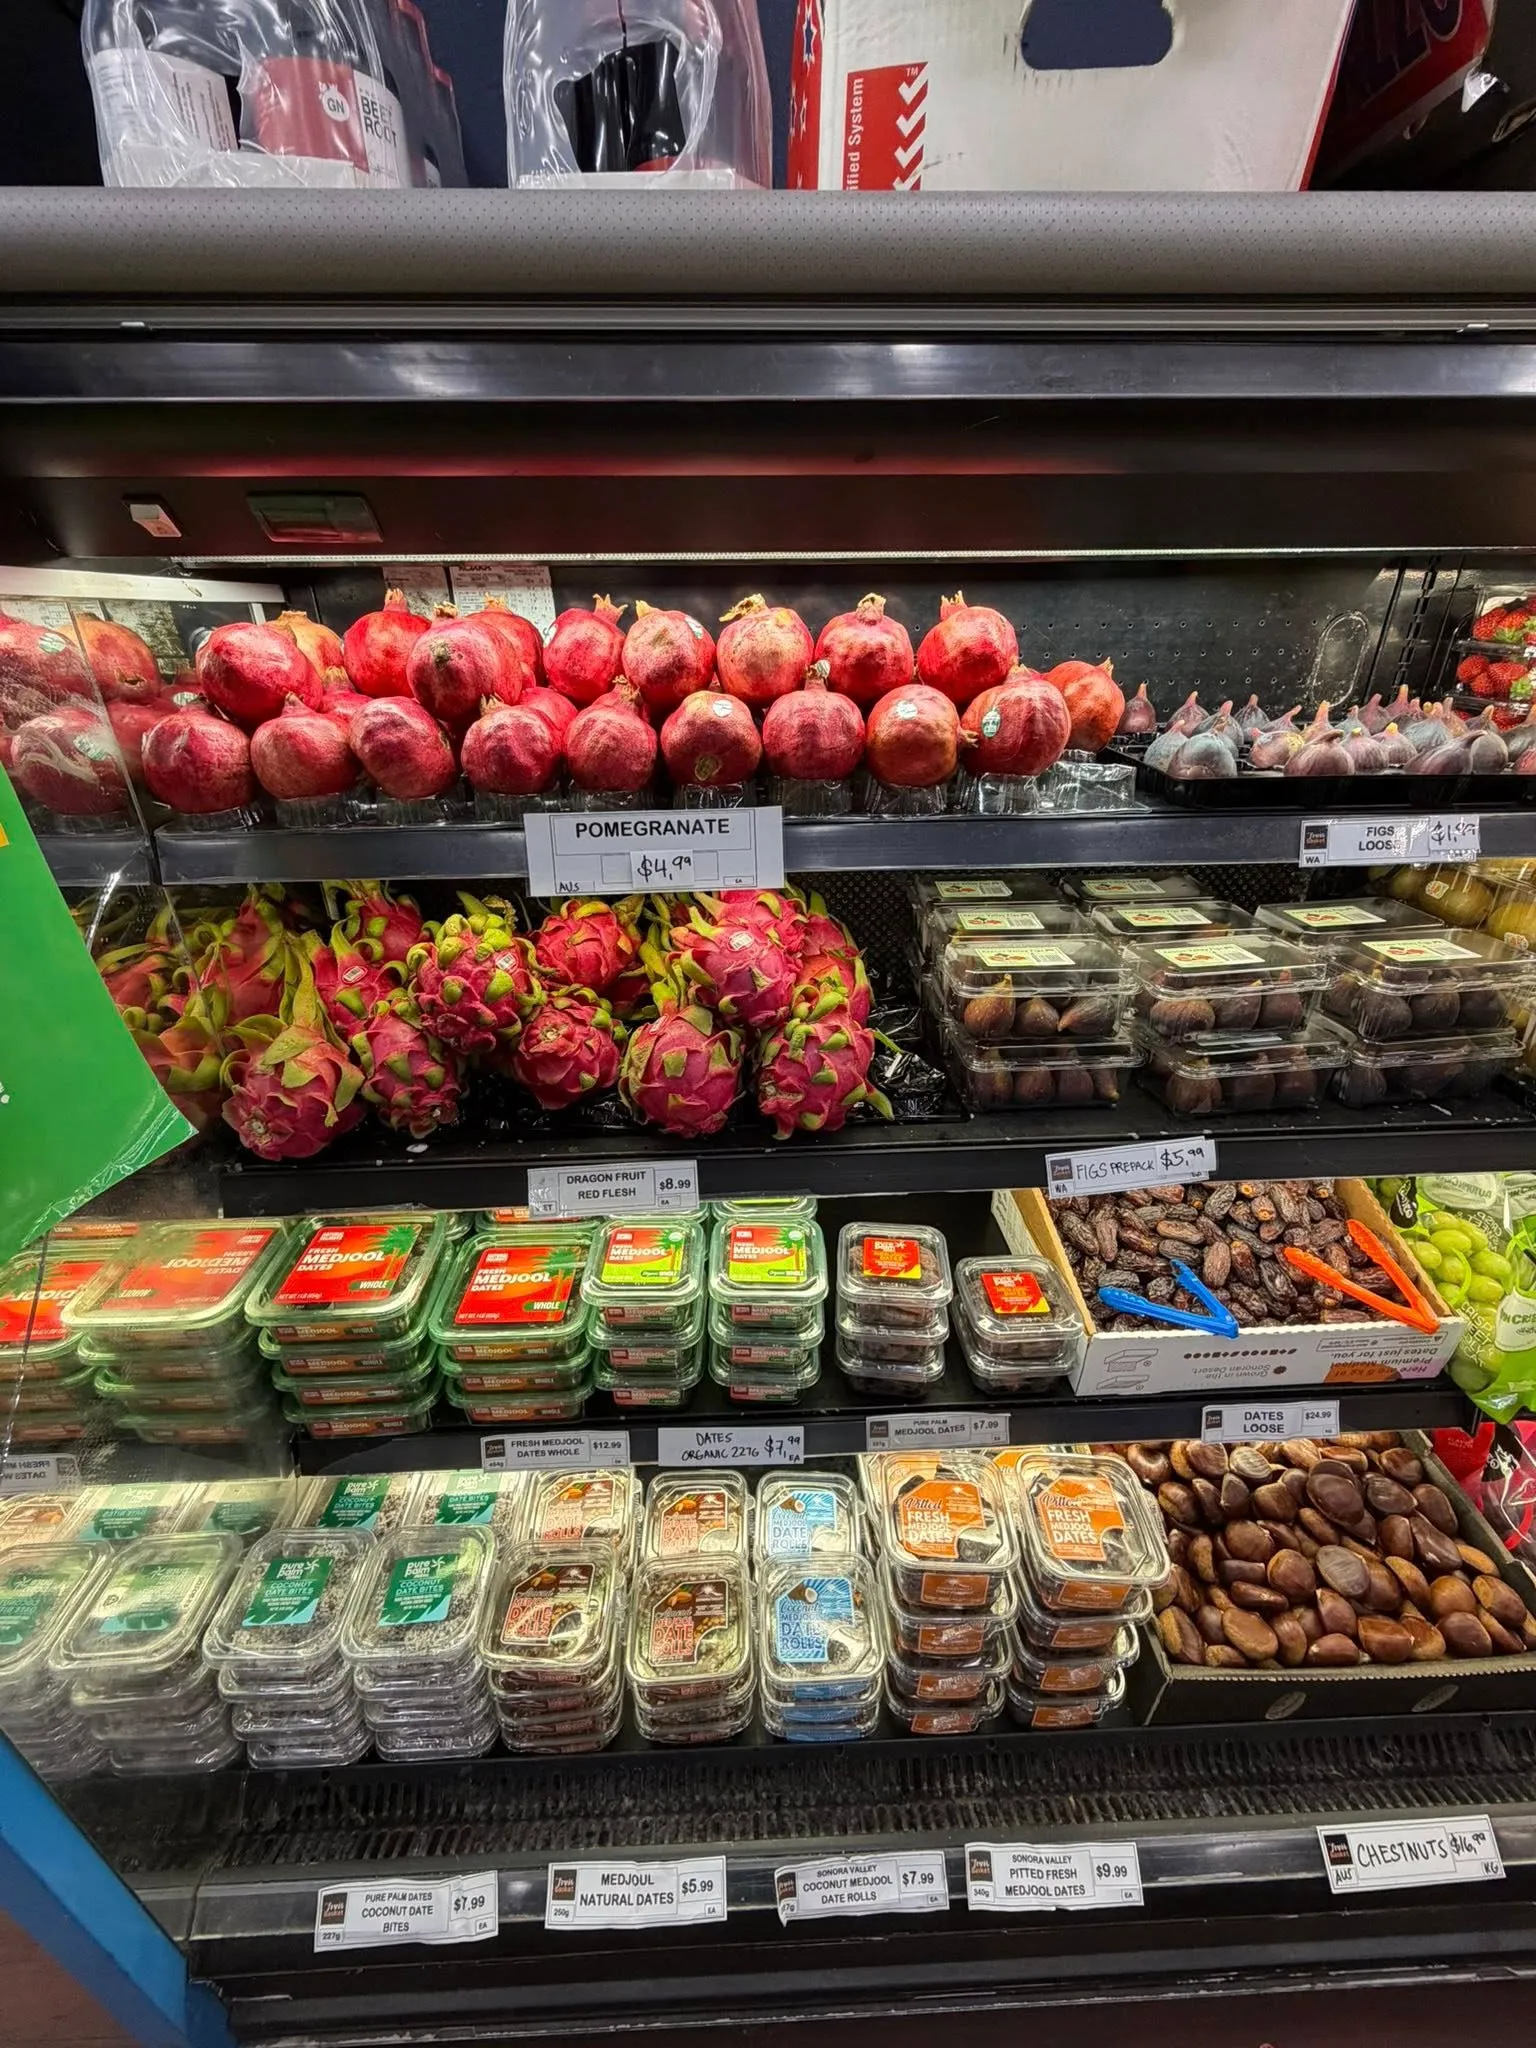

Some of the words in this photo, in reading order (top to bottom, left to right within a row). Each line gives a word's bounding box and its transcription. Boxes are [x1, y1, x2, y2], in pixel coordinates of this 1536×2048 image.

[327, 98, 345, 115] GN
[848, 78, 864, 146] System
[575, 818, 731, 838] POMEGRANATE
[1366, 826, 1395, 837] FIGS
[1305, 856, 1320, 864] WA
[559, 881, 580, 892] AUS
[1076, 1160, 1108, 1180] FIGS
[1110, 1158, 1155, 1175] PREPACK
[566, 1173, 613, 1185] DRAGON
[615, 1171, 646, 1182] FRUIT
[659, 1177, 691, 1191] $8.99
[578, 1190, 600, 1200] RED
[602, 1187, 636, 1198] FLESH
[610, 1248, 667, 1256] MEDJOOL
[733, 1247, 790, 1255] MEDJOOL
[302, 1251, 385, 1263] MEDJOOL
[297, 1263, 334, 1271] DATES
[473, 1272, 552, 1284] MEDJOOL
[359, 1280, 389, 1290] WHOLE
[533, 1302, 561, 1310] WHOLE
[1357, 1350, 1375, 1358] for
[1404, 1347, 1438, 1355] Dates
[1381, 1357, 1433, 1365] Premium
[1244, 1411, 1284, 1421] DATES
[1305, 1411, 1331, 1420] $24.99
[895, 1427, 936, 1436] MEDJOOL
[938, 1424, 966, 1434] DATES
[973, 1420, 999, 1430] $7.99
[1243, 1423, 1285, 1433] LOOSE
[511, 1439, 540, 1448] FRESH
[542, 1438, 585, 1446] MEDJOOL
[695, 1432, 733, 1446] DATES
[593, 1441, 622, 1450] $12.99
[517, 1449, 546, 1458] DATES
[548, 1448, 580, 1456] WHOLE
[681, 1448, 728, 1461] ORGANIC
[789, 1454, 800, 1462] EA
[905, 1497, 943, 1510] Pitted
[907, 1511, 951, 1523] FRESH
[1047, 1509, 1091, 1522] FRESH
[1049, 1522, 1094, 1531] MEDJOOL
[773, 1527, 807, 1538] DATE
[908, 1530, 953, 1543] DATES
[1053, 1530, 1098, 1545] DATES
[772, 1538, 807, 1549] ROLLS
[280, 1562, 304, 1571] pure
[407, 1560, 431, 1570] pure
[276, 1567, 303, 1579] palm
[404, 1567, 430, 1578] palm
[270, 1581, 312, 1589] COCONUT
[400, 1580, 440, 1588] COCONUT
[265, 1588, 287, 1597] DATE
[288, 1587, 313, 1596] BITES
[396, 1588, 418, 1596] DATE
[420, 1585, 445, 1594] BITES
[654, 1625, 693, 1641] DATE
[781, 1637, 822, 1650] ROLLS
[1357, 1839, 1448, 1868] CHESTNUTS
[1012, 1854, 1044, 1864] SONORA
[1045, 1855, 1072, 1865] VALLEY
[817, 1867, 848, 1878] SONORA
[850, 1864, 877, 1874] VALLEY
[1010, 1868, 1044, 1879] PITTED
[1046, 1868, 1077, 1880] FRESH
[1096, 1863, 1128, 1879] $9.99
[1483, 1862, 1499, 1875] KG
[601, 1873, 655, 1887] MEDJOUL
[902, 1871, 934, 1887] $7.99
[1335, 1868, 1353, 1884] AUS
[681, 1879, 714, 1897] $5.99
[803, 1879, 847, 1892] COCONUT
[850, 1875, 893, 1888] MEDJOOL
[973, 1889, 989, 1898] 340g
[1005, 1885, 1052, 1897] MEDJOOL
[1054, 1884, 1086, 1896] DATES
[365, 1893, 386, 1903] PURE
[387, 1892, 407, 1902] PALM
[408, 1892, 433, 1901] DATES
[579, 1893, 634, 1906] NATURAL
[636, 1892, 674, 1906] DATES
[821, 1894, 847, 1904] DATE
[847, 1891, 877, 1902] ROLLS
[453, 1895, 485, 1913] $7.99
[362, 1906, 407, 1918] COCONUT
[409, 1905, 434, 1916] DATE
[553, 1908, 570, 1918] 250g
[383, 1922, 410, 1933] BITES
[478, 1922, 488, 1930] EA
[322, 1932, 341, 1941] 227g
